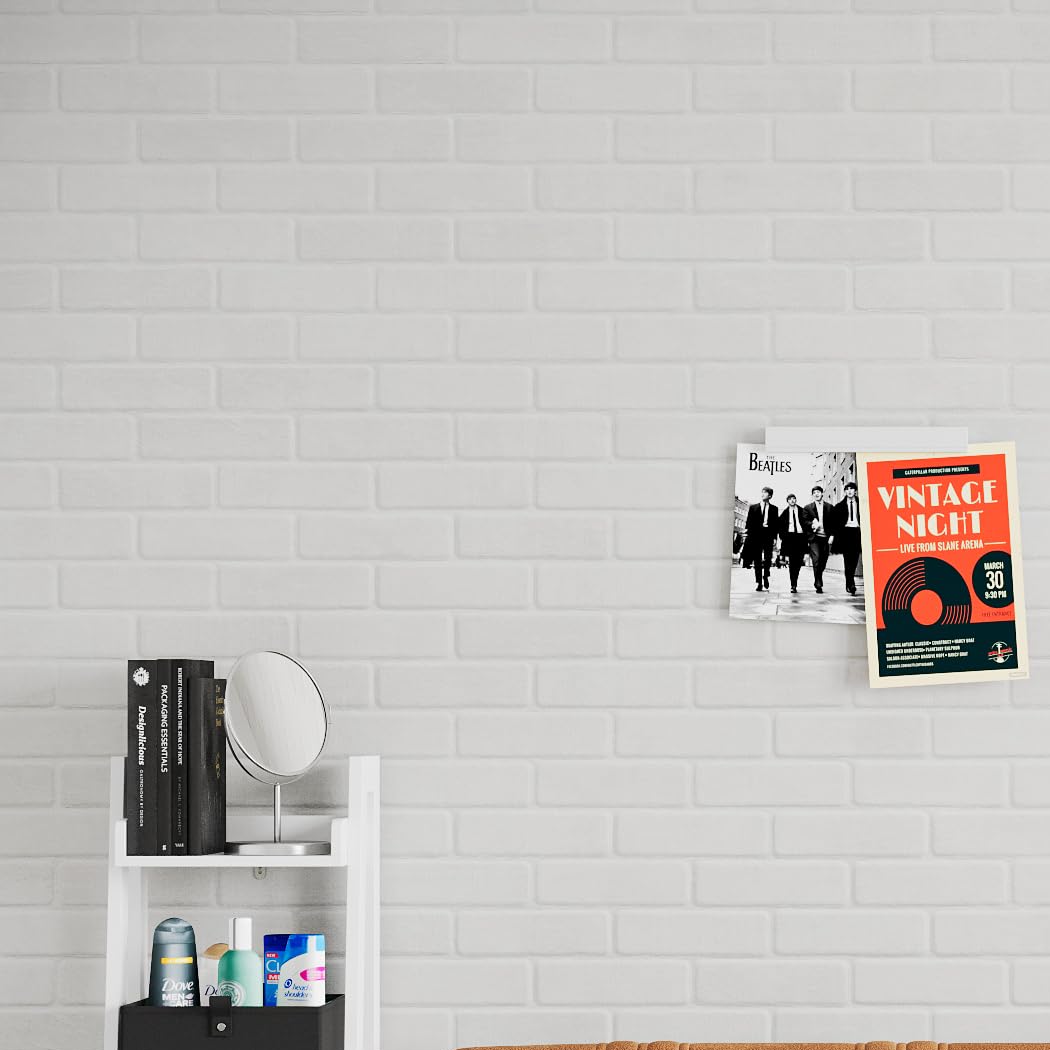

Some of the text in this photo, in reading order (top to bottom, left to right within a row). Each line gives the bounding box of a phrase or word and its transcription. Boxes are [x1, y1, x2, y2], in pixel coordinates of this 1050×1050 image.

[749, 452, 792, 476] BEATLES
[877, 480, 998, 510] VINTAGE
[896, 510, 984, 538] NIGHT
[900, 540, 984, 554] LIVE FROM SLANE ARENA
[984, 562, 1004, 570] MARCH
[986, 570, 1004, 590] 30
[984, 590, 1007, 599] 9:30 PM
[136, 706, 146, 766] Designlicious
[160, 684, 168, 772] PACKAGING ESSENTIALS
[266, 960, 280, 972] CL
[162, 978, 194, 991] Dove
